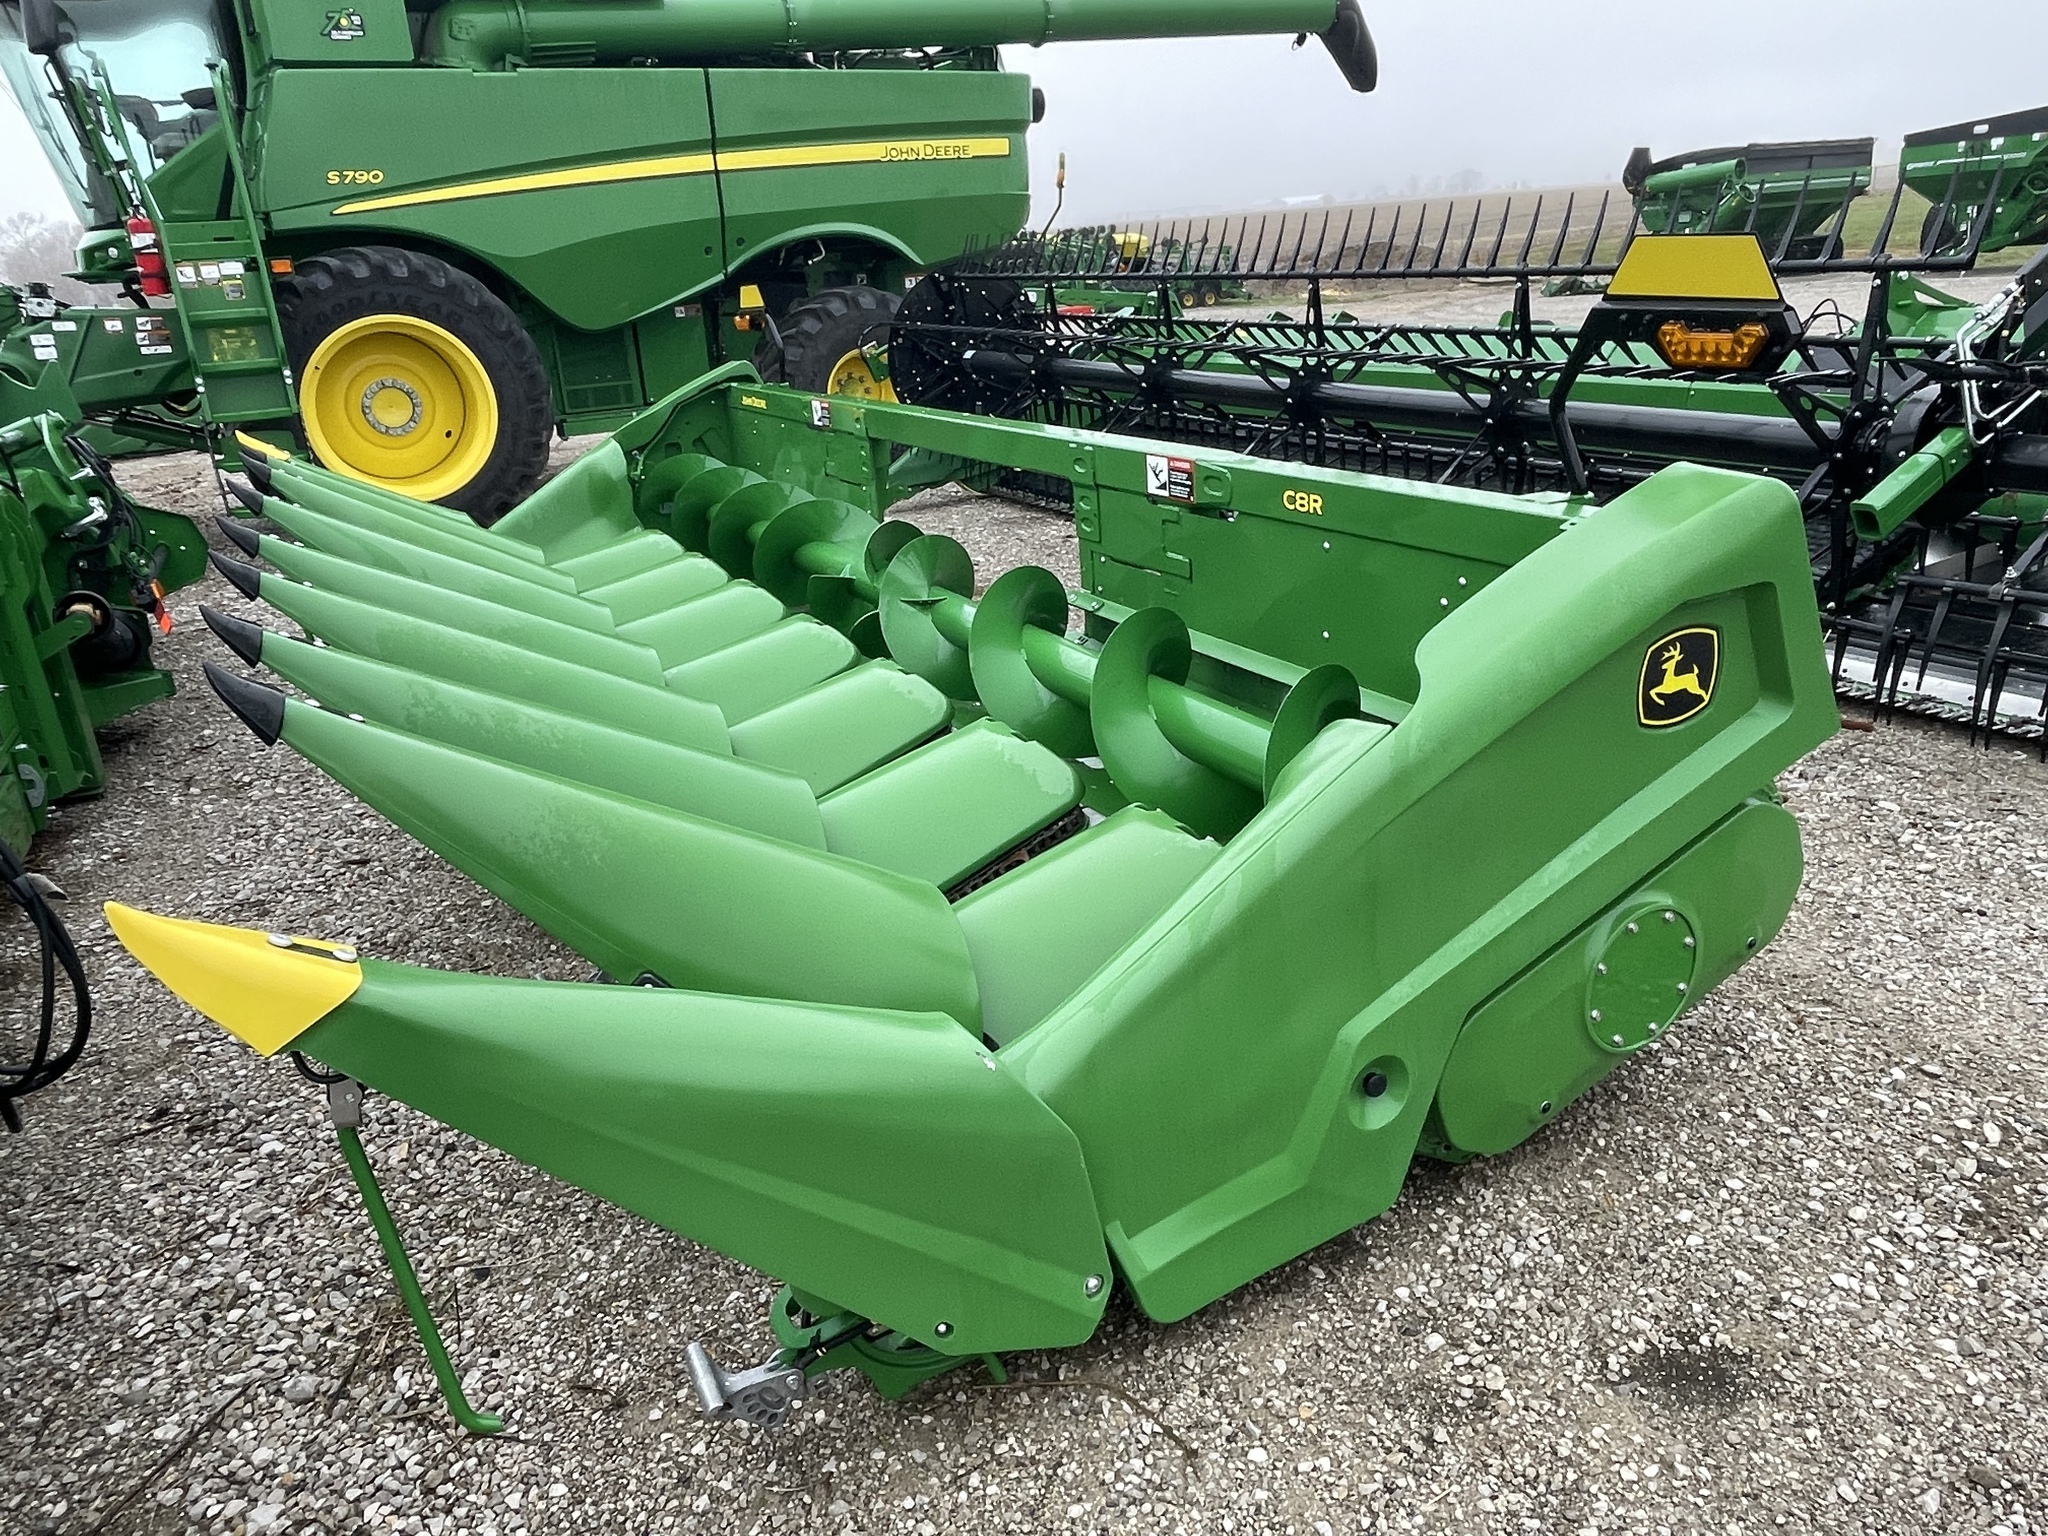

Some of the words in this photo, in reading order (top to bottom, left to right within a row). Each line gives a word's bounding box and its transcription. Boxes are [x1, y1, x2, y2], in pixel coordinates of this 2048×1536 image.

[880, 145, 920, 159] JOHN
[923, 143, 970, 157] DEERE
[326, 169, 384, 185] S790
[1282, 489, 1323, 516] C8R
